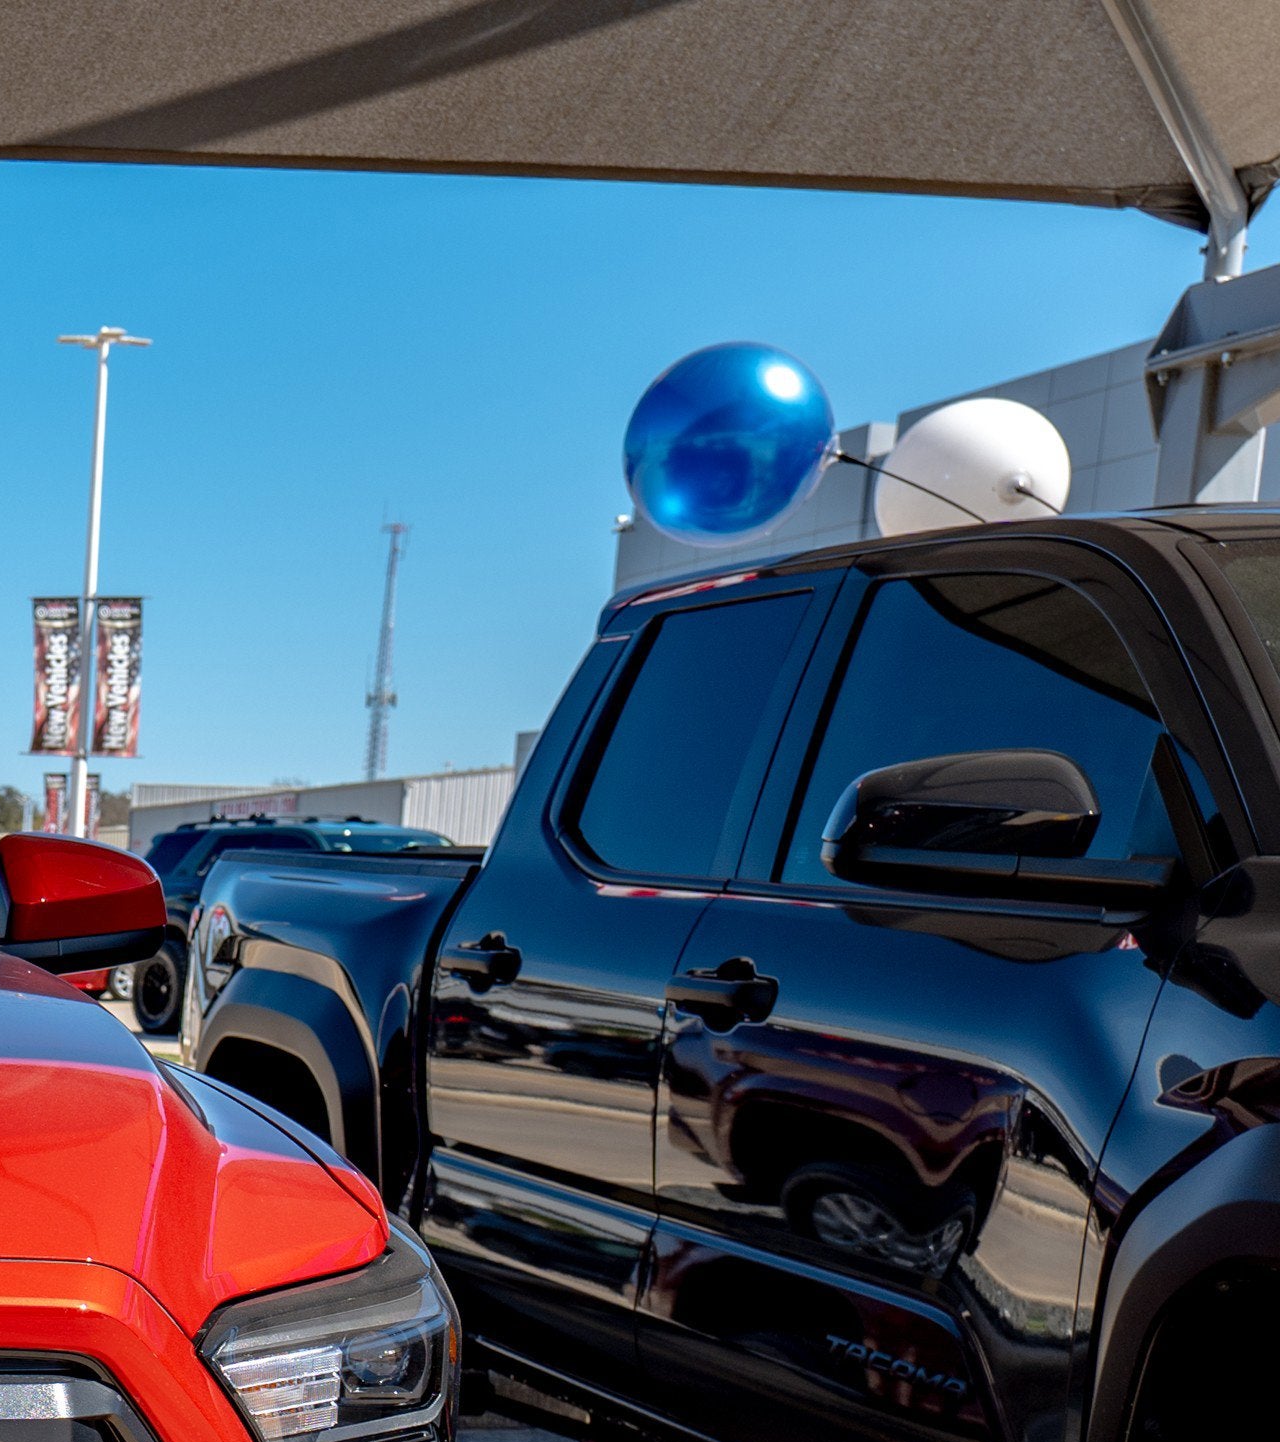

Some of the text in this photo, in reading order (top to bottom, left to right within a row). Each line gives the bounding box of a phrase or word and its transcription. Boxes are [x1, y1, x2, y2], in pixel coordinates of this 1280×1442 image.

[45, 634, 68, 708] Vehicles
[107, 634, 130, 707] Vehicles
[42, 708, 67, 748] New
[103, 709, 127, 748] New
[826, 1334, 968, 1394] TACOMA
